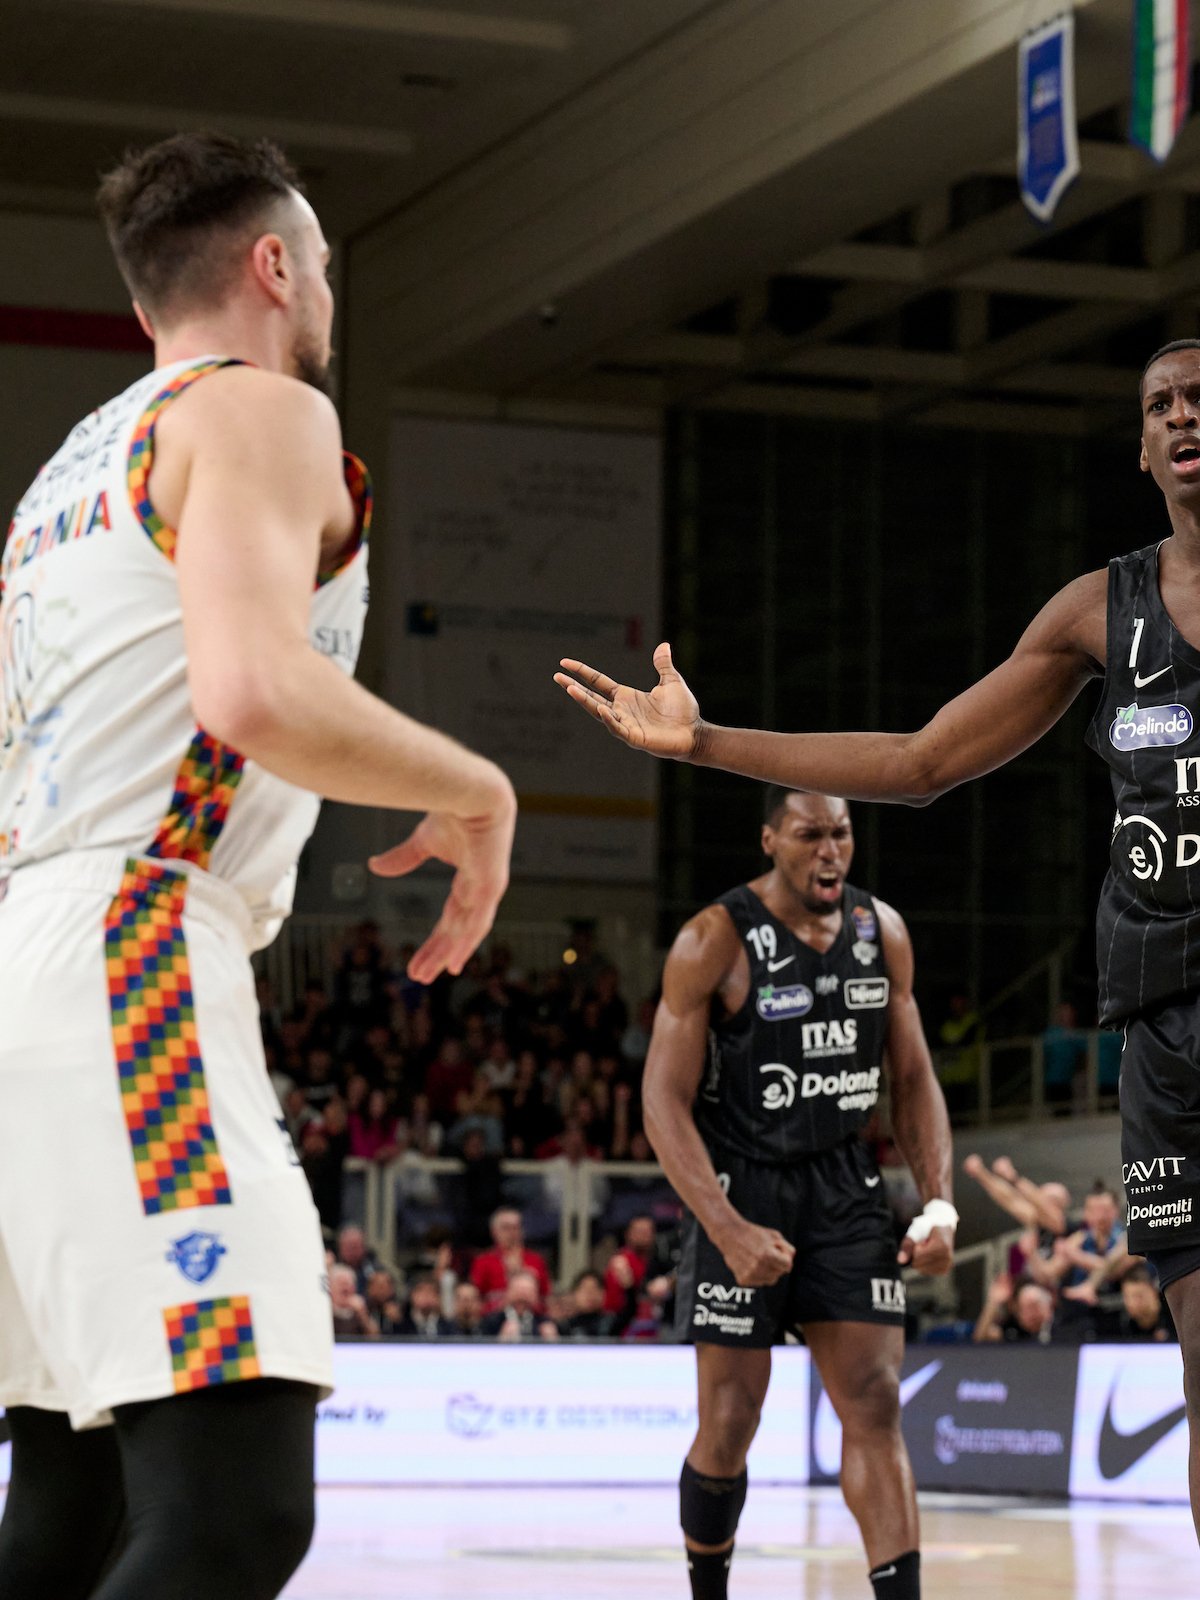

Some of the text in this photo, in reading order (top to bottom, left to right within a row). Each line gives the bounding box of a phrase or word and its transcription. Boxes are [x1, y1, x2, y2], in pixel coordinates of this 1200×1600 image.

[1114, 713, 1189, 740] Melinda
[746, 923, 778, 961] 19
[801, 1018, 858, 1051] ITAS
[1130, 1183, 1164, 1195] TRENTO
[1131, 1198, 1193, 1221] Dolomiti
[1148, 1213, 1193, 1228] energia
[870, 1277, 907, 1305] ITA
